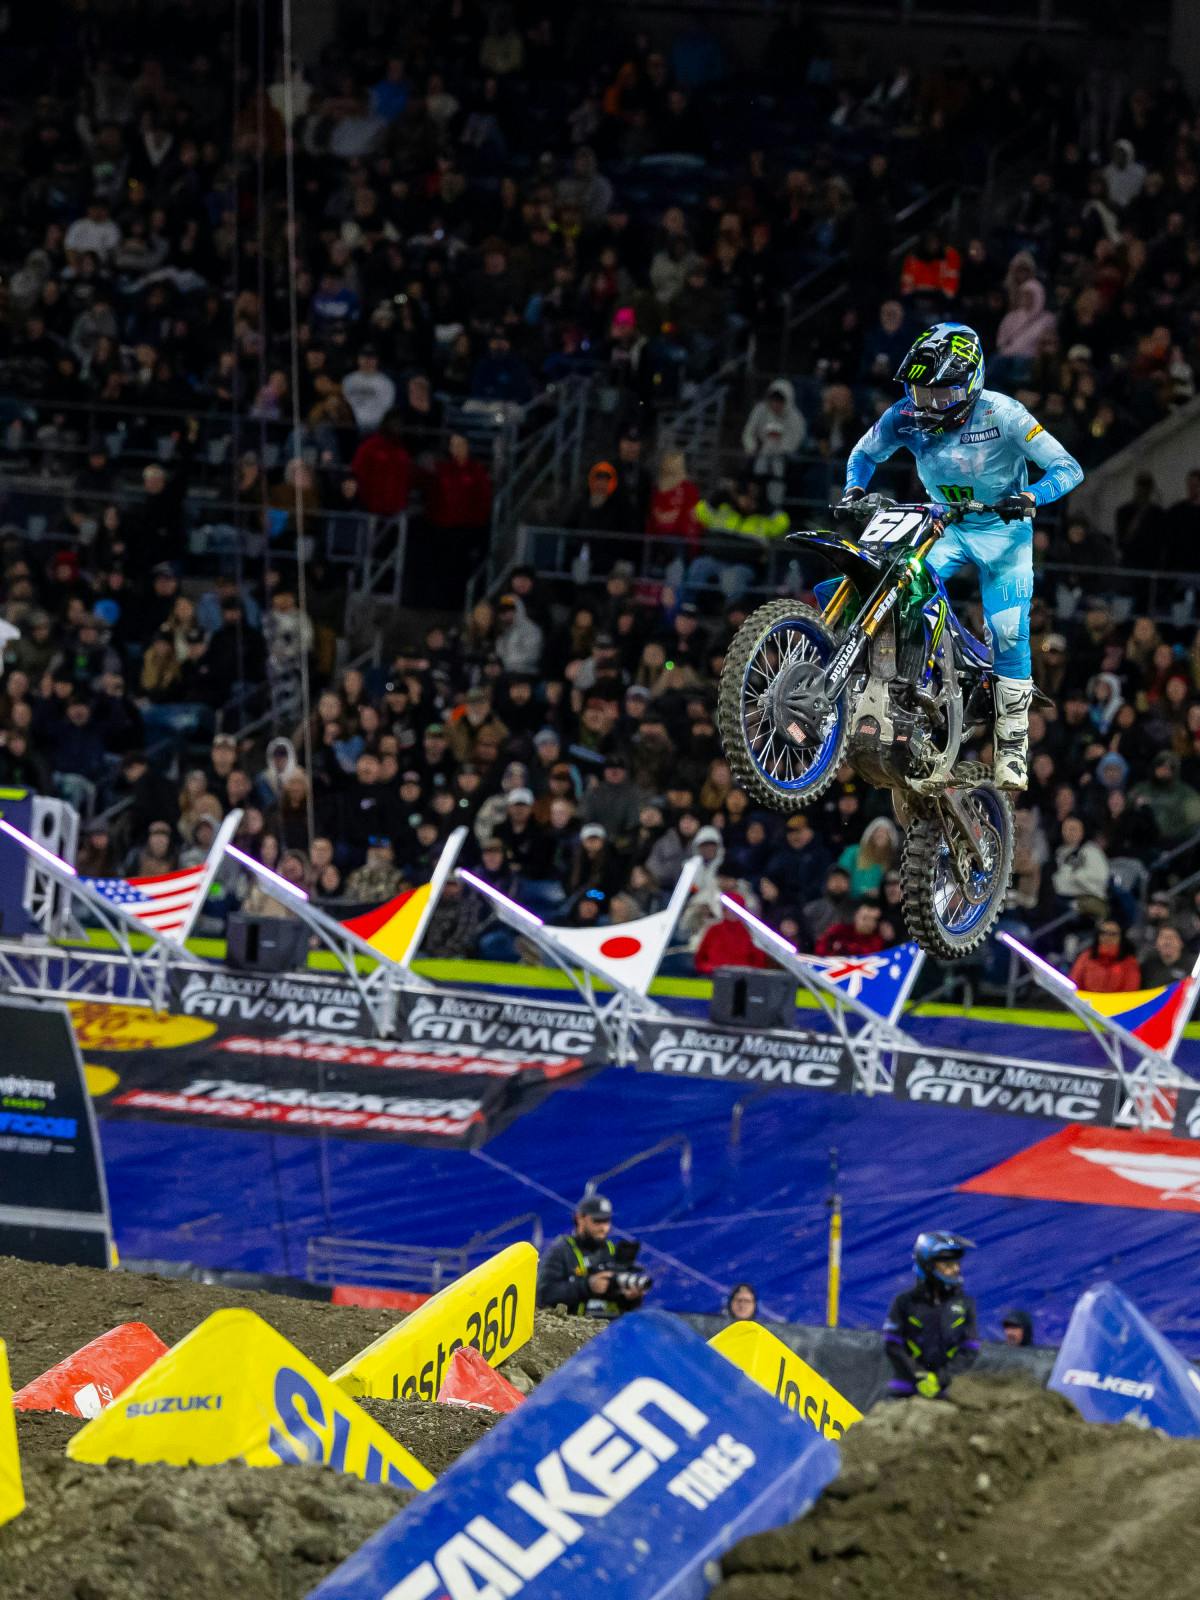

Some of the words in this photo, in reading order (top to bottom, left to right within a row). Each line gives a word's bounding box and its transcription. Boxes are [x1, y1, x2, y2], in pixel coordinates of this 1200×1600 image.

[970, 428, 999, 442] YAMAHA
[858, 512, 923, 543] 61
[829, 637, 859, 683] DUNLOP
[210, 973, 266, 995] ROCKY
[267, 979, 361, 1006] MOUNTAIN
[439, 998, 498, 1021] ROCKY
[500, 1005, 596, 1032] MOUNTAIN
[681, 1029, 739, 1052] ROCKY
[740, 1035, 843, 1063] MOUNTAIN
[939, 1059, 1000, 1084] ROCKY
[1001, 1067, 1104, 1096] MOUNTAIN
[1062, 1368, 1155, 1400] FALKEN
[126, 1394, 222, 1418] SUZUKI
[666, 1432, 756, 1510] TIRES
